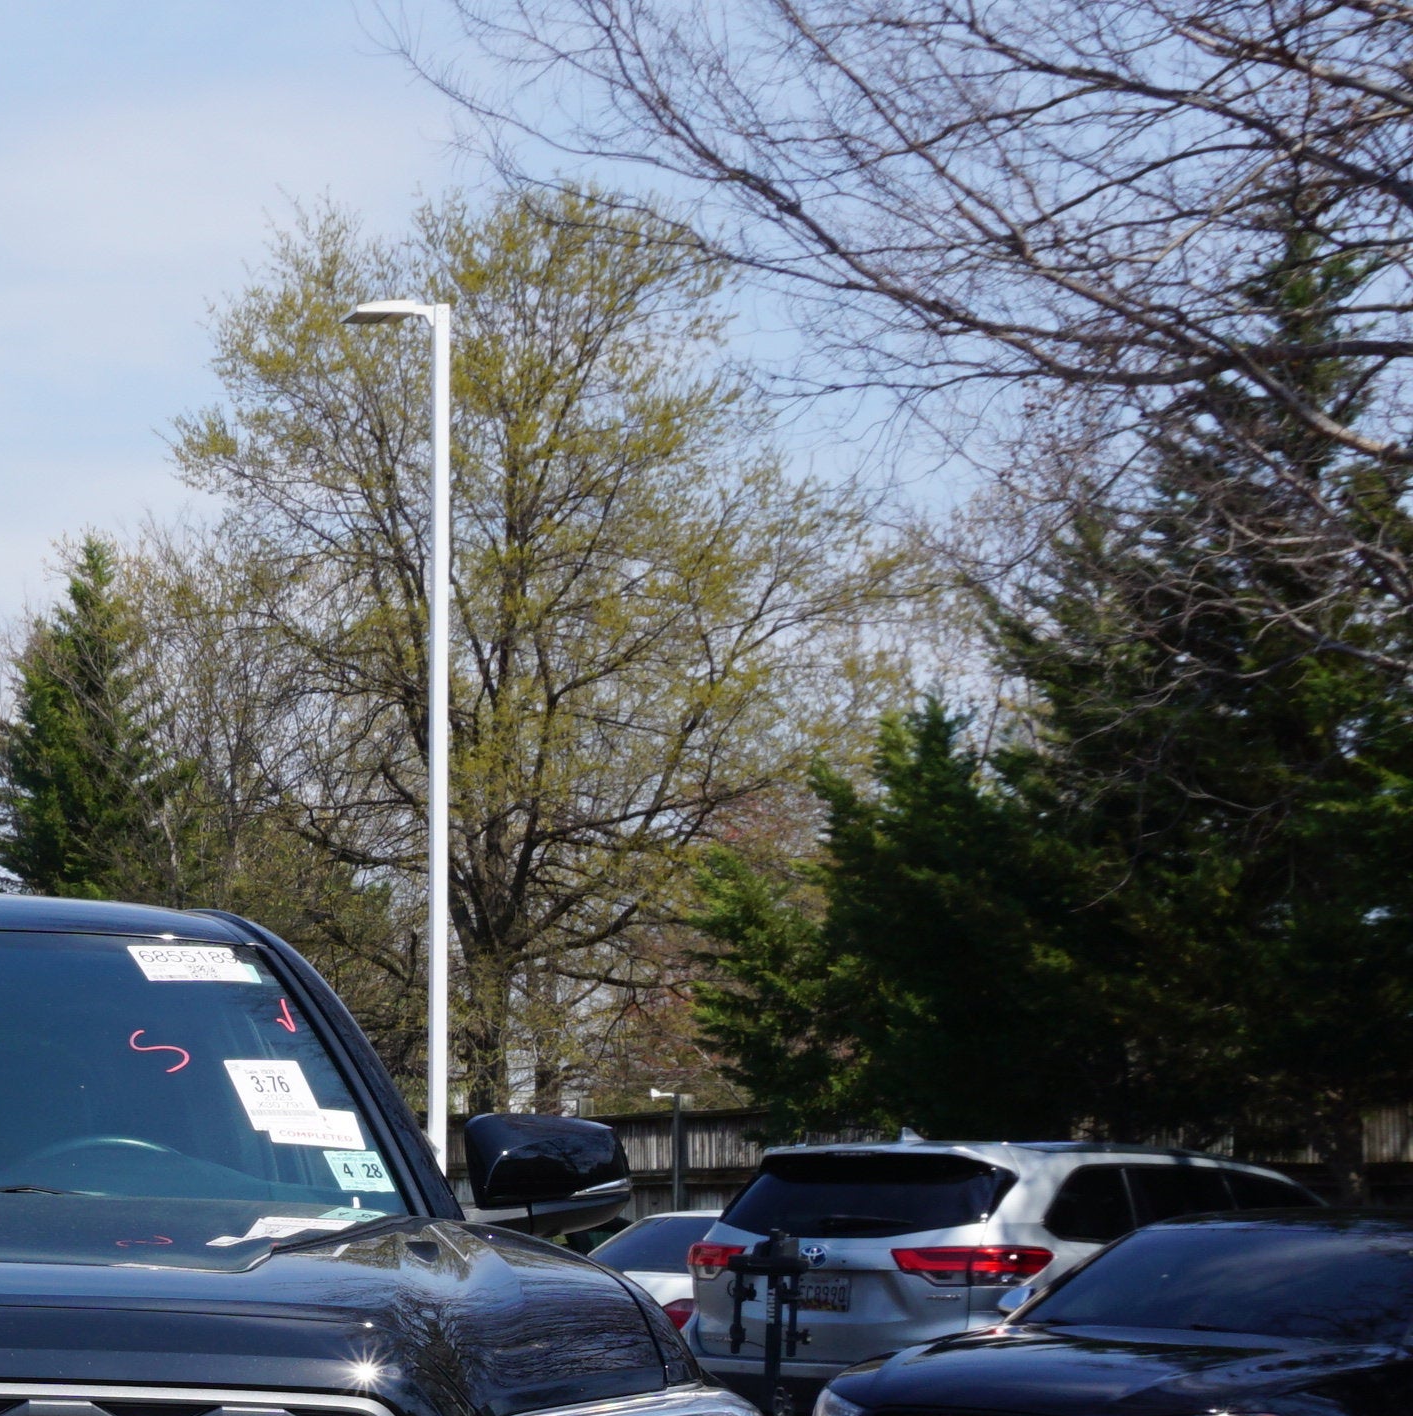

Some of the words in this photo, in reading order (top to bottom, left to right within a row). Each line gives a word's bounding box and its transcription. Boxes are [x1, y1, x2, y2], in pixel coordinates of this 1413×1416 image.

[138, 949, 238, 965] 6855189
[278, 1129, 354, 1143] COMPLETED
[342, 1162, 355, 1178] 4
[361, 1163, 383, 1179] 28
